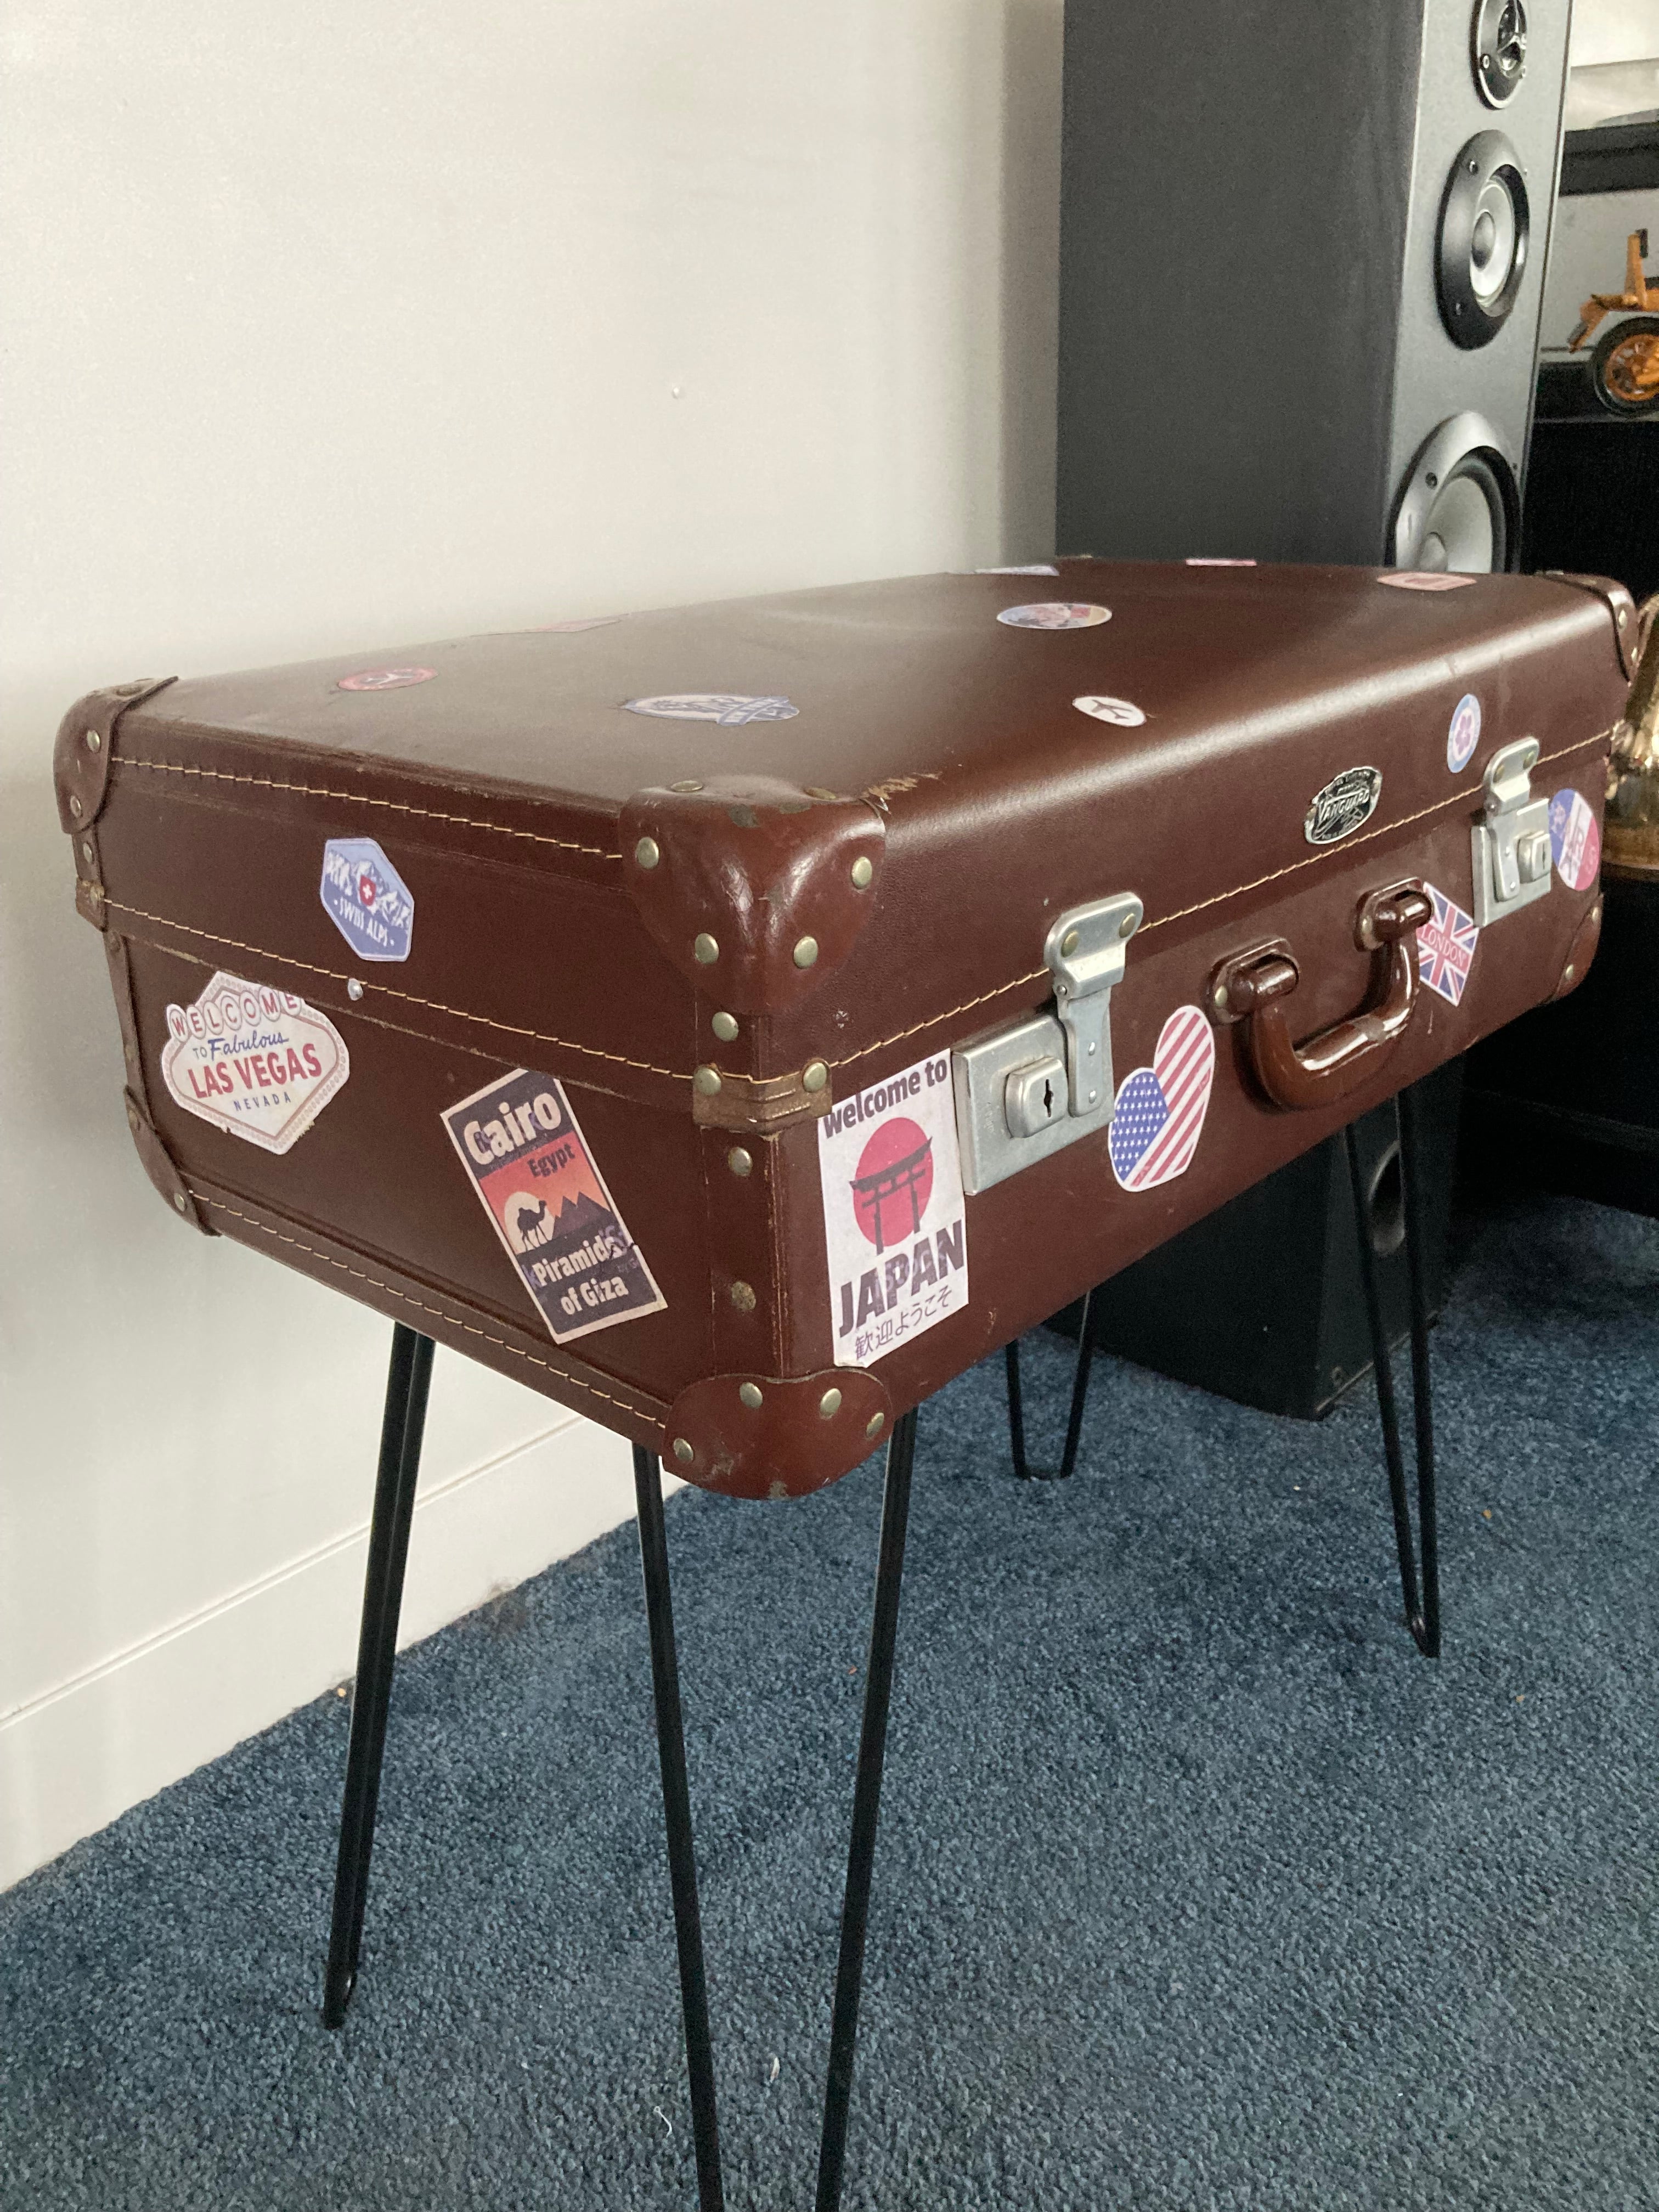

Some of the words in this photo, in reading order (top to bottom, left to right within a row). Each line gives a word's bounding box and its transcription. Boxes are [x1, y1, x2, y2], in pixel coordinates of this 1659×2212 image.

[1421, 926, 1466, 967] LONDON
[172, 992, 297, 1036] WELCOME
[207, 1030, 289, 1061] Fabulous
[188, 1062, 234, 1098] LAS
[233, 1043, 322, 1090] VEGAS
[924, 1059, 947, 1087] to
[234, 1091, 291, 1111] NEVADA
[464, 1092, 561, 1165] Cairo
[527, 1143, 575, 1178] Egypt
[561, 1286, 583, 1316] of
[580, 1276, 629, 1307] Giza
[839, 1219, 965, 1338] JAPAN
[855, 1285, 952, 1360] 歓迎ようこそ
